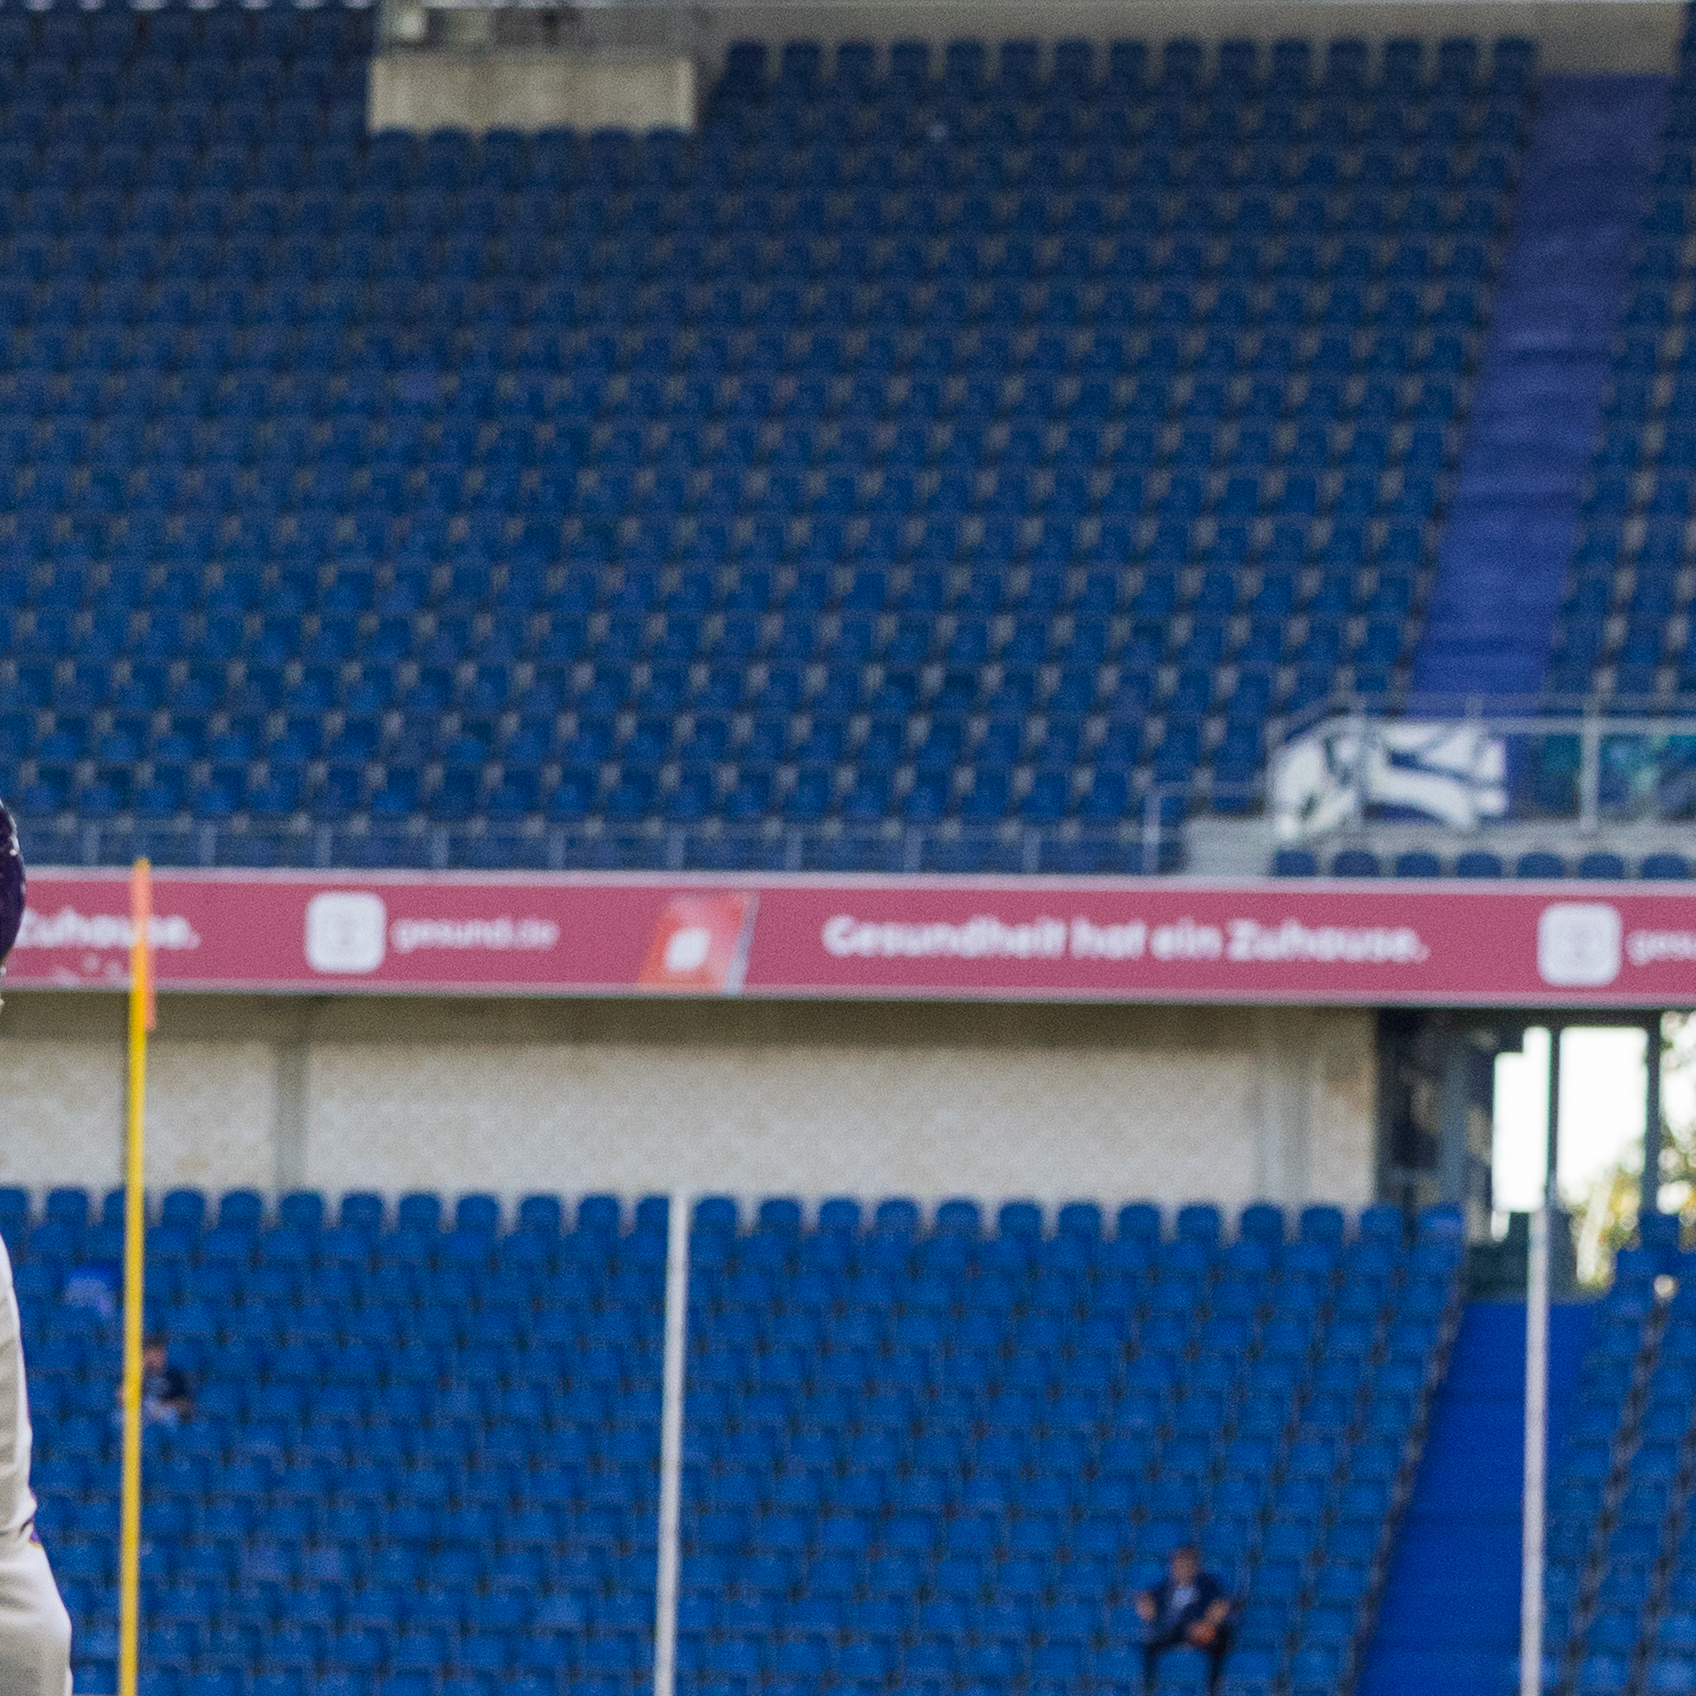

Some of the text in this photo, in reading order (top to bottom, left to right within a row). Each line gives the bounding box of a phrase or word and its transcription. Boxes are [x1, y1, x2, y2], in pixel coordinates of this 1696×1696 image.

[392, 916, 560, 954] gesund.de
[822, 914, 1431, 963] Gesundheit hat ein Zuhause.
